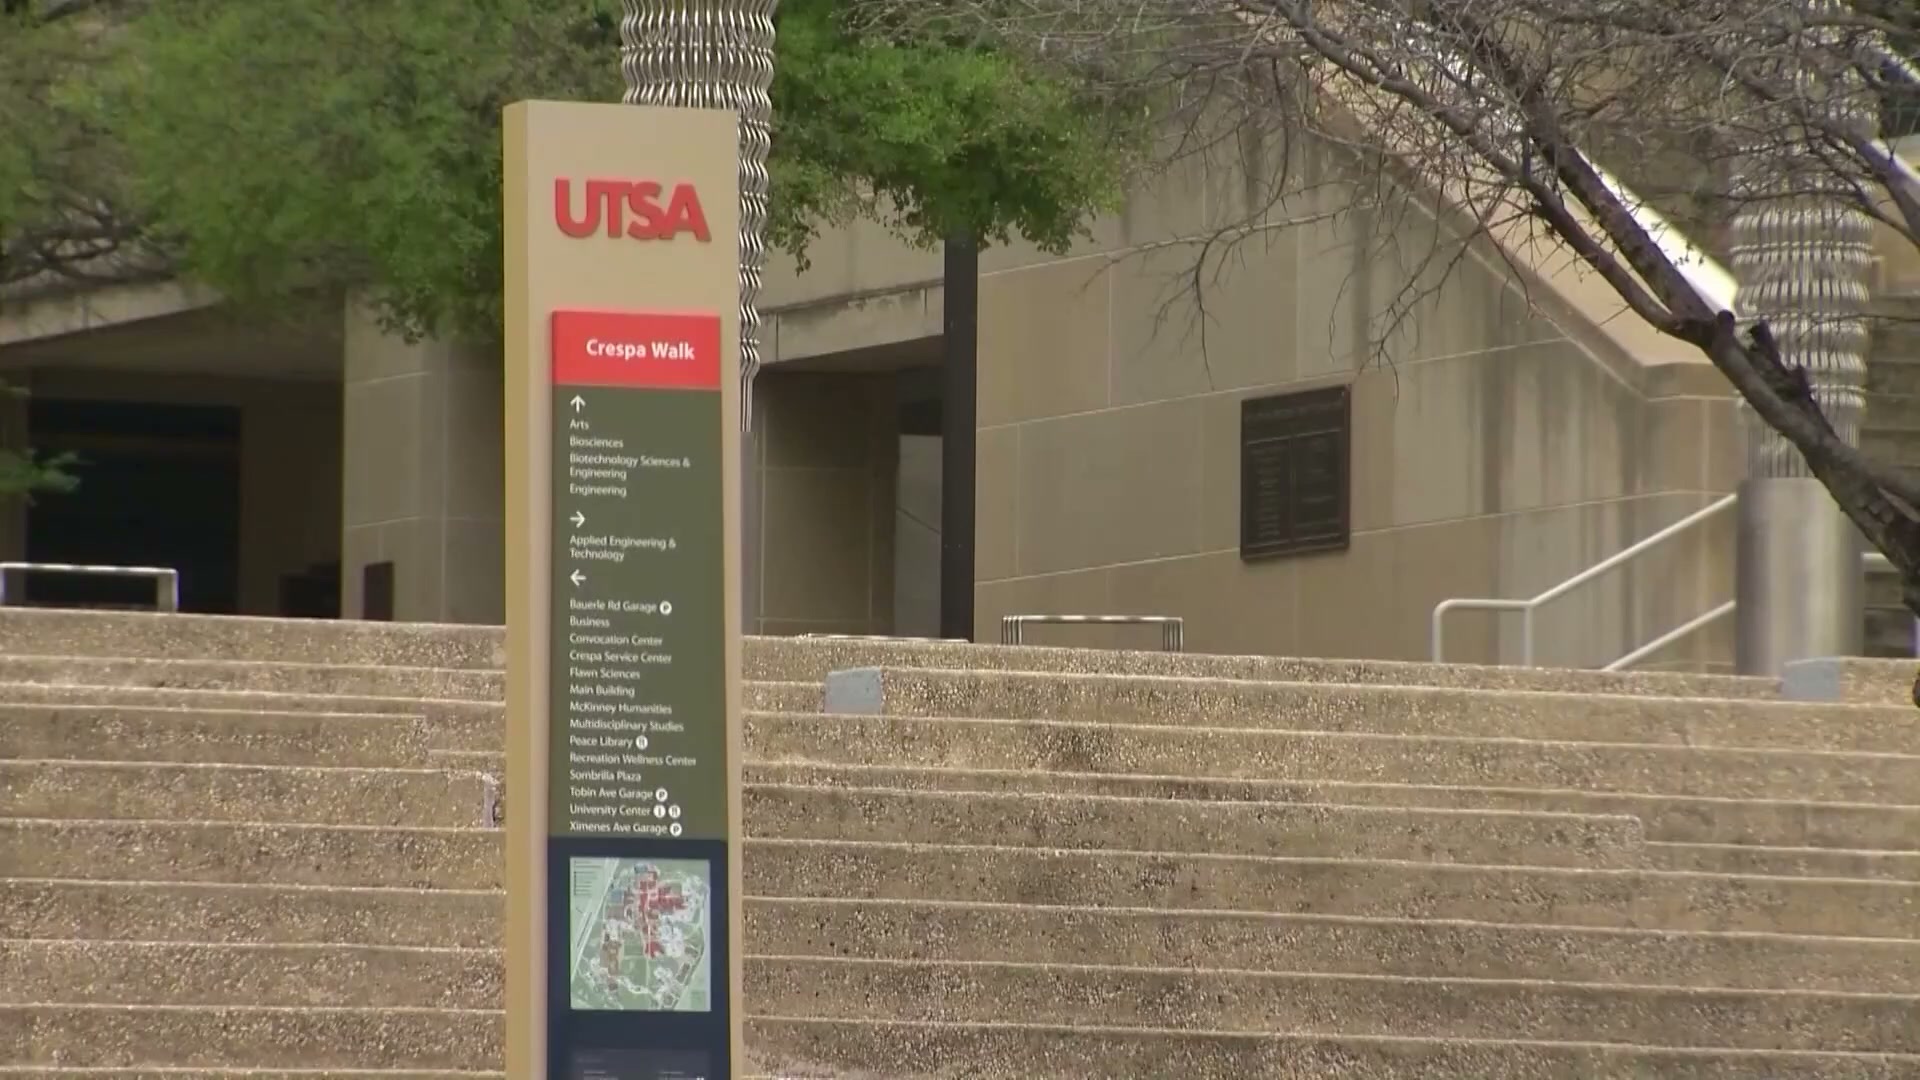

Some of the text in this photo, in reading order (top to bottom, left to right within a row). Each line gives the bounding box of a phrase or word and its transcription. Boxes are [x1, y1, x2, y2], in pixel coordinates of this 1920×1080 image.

[555, 178, 712, 242] UTSA
[586, 339, 695, 360] Crespa Walk
[570, 419, 589, 430] Arts
[570, 437, 623, 448] Biosciences
[570, 454, 690, 467] Biotechnology Sciences &
[570, 468, 627, 480] Engineering
[570, 484, 627, 497] Engineering
[570, 536, 676, 550] Applied Engineering &
[570, 550, 624, 561] Technology
[570, 600, 605, 610] Bauerle
[608, 600, 620, 611] Rd
[623, 601, 656, 614] Garage
[570, 617, 610, 628] Business
[570, 634, 662, 646] Convocation Center
[570, 651, 672, 664] Crespa Service Center
[570, 668, 640, 679] Flawn Sciences
[570, 685, 635, 698] Main Building
[570, 701, 672, 714] McKinney Humanities
[570, 719, 684, 732] Multidisciplinary Studies
[570, 736, 633, 749] Peace Library
[570, 753, 696, 766] Recreation Wellness Center
[570, 770, 641, 782] Sombrilla Plaza
[570, 787, 596, 798] Tobin
[599, 788, 617, 798] Ave
[619, 789, 653, 801] Garage
[570, 805, 650, 818] University Center
[570, 822, 610, 833] Ximenes
[613, 823, 630, 833] Ave
[633, 824, 667, 836] Garage
